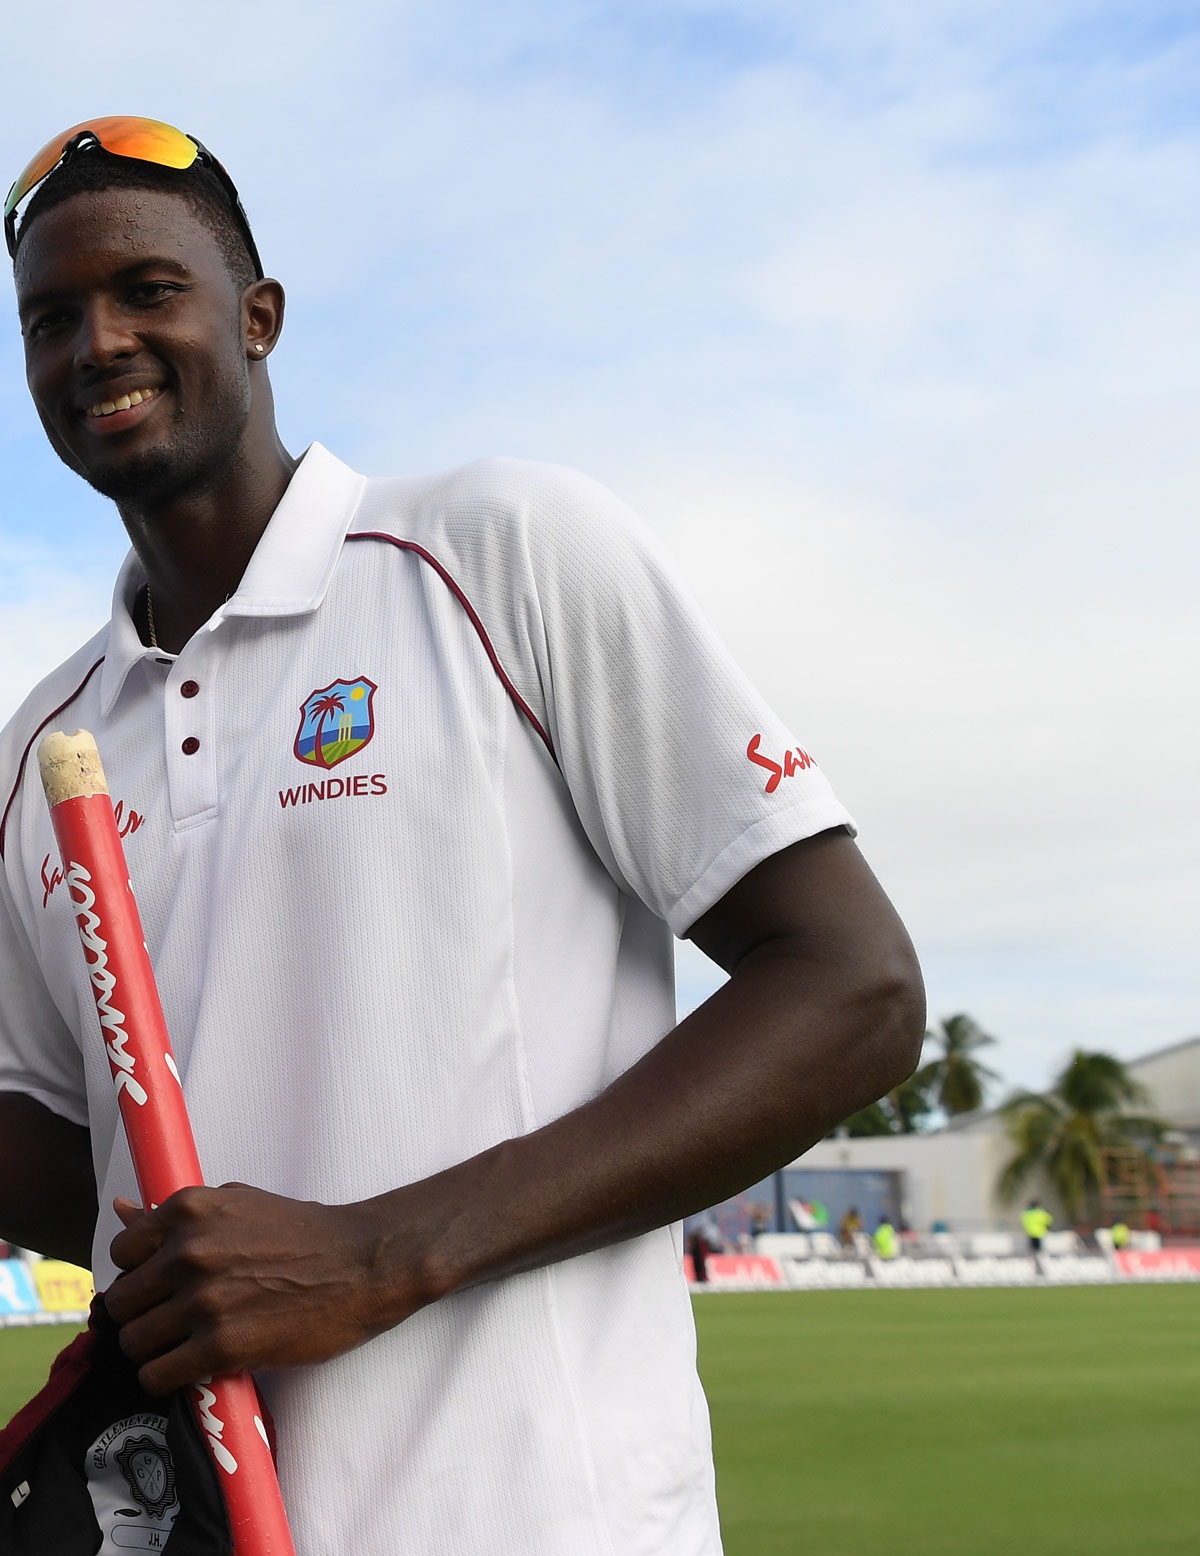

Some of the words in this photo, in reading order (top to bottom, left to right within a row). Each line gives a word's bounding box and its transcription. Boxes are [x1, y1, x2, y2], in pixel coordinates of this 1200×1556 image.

[279, 774, 388, 808] WINDIES
[93, 1415, 141, 1470] GENTLEMEN
[137, 1468, 145, 1480] G
[156, 1470, 162, 1482] P
[16, 1487, 27, 1498] L
